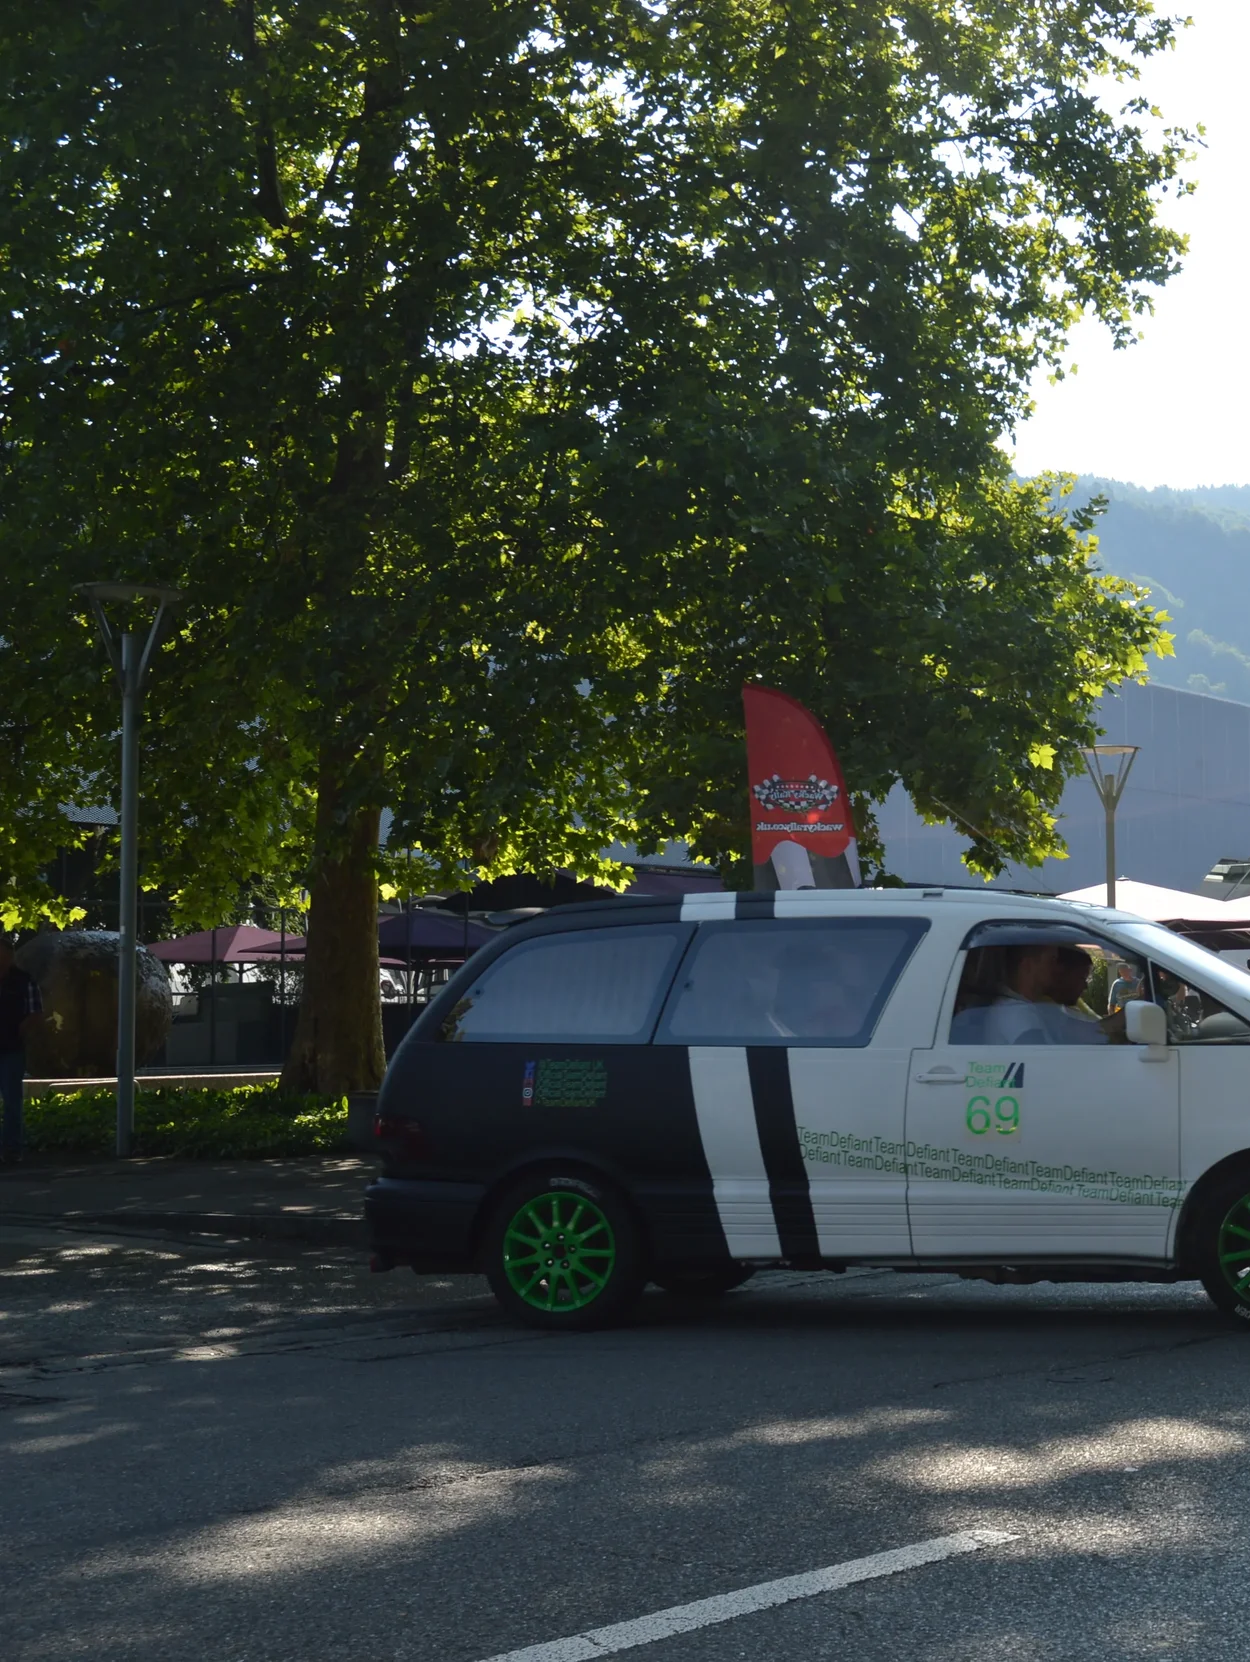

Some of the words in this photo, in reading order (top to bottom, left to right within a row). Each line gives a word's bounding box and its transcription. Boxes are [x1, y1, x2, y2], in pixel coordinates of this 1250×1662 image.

[968, 1061, 1006, 1073] Team
[966, 1075, 1017, 1088] Defiant
[966, 1095, 1020, 1135] 69
